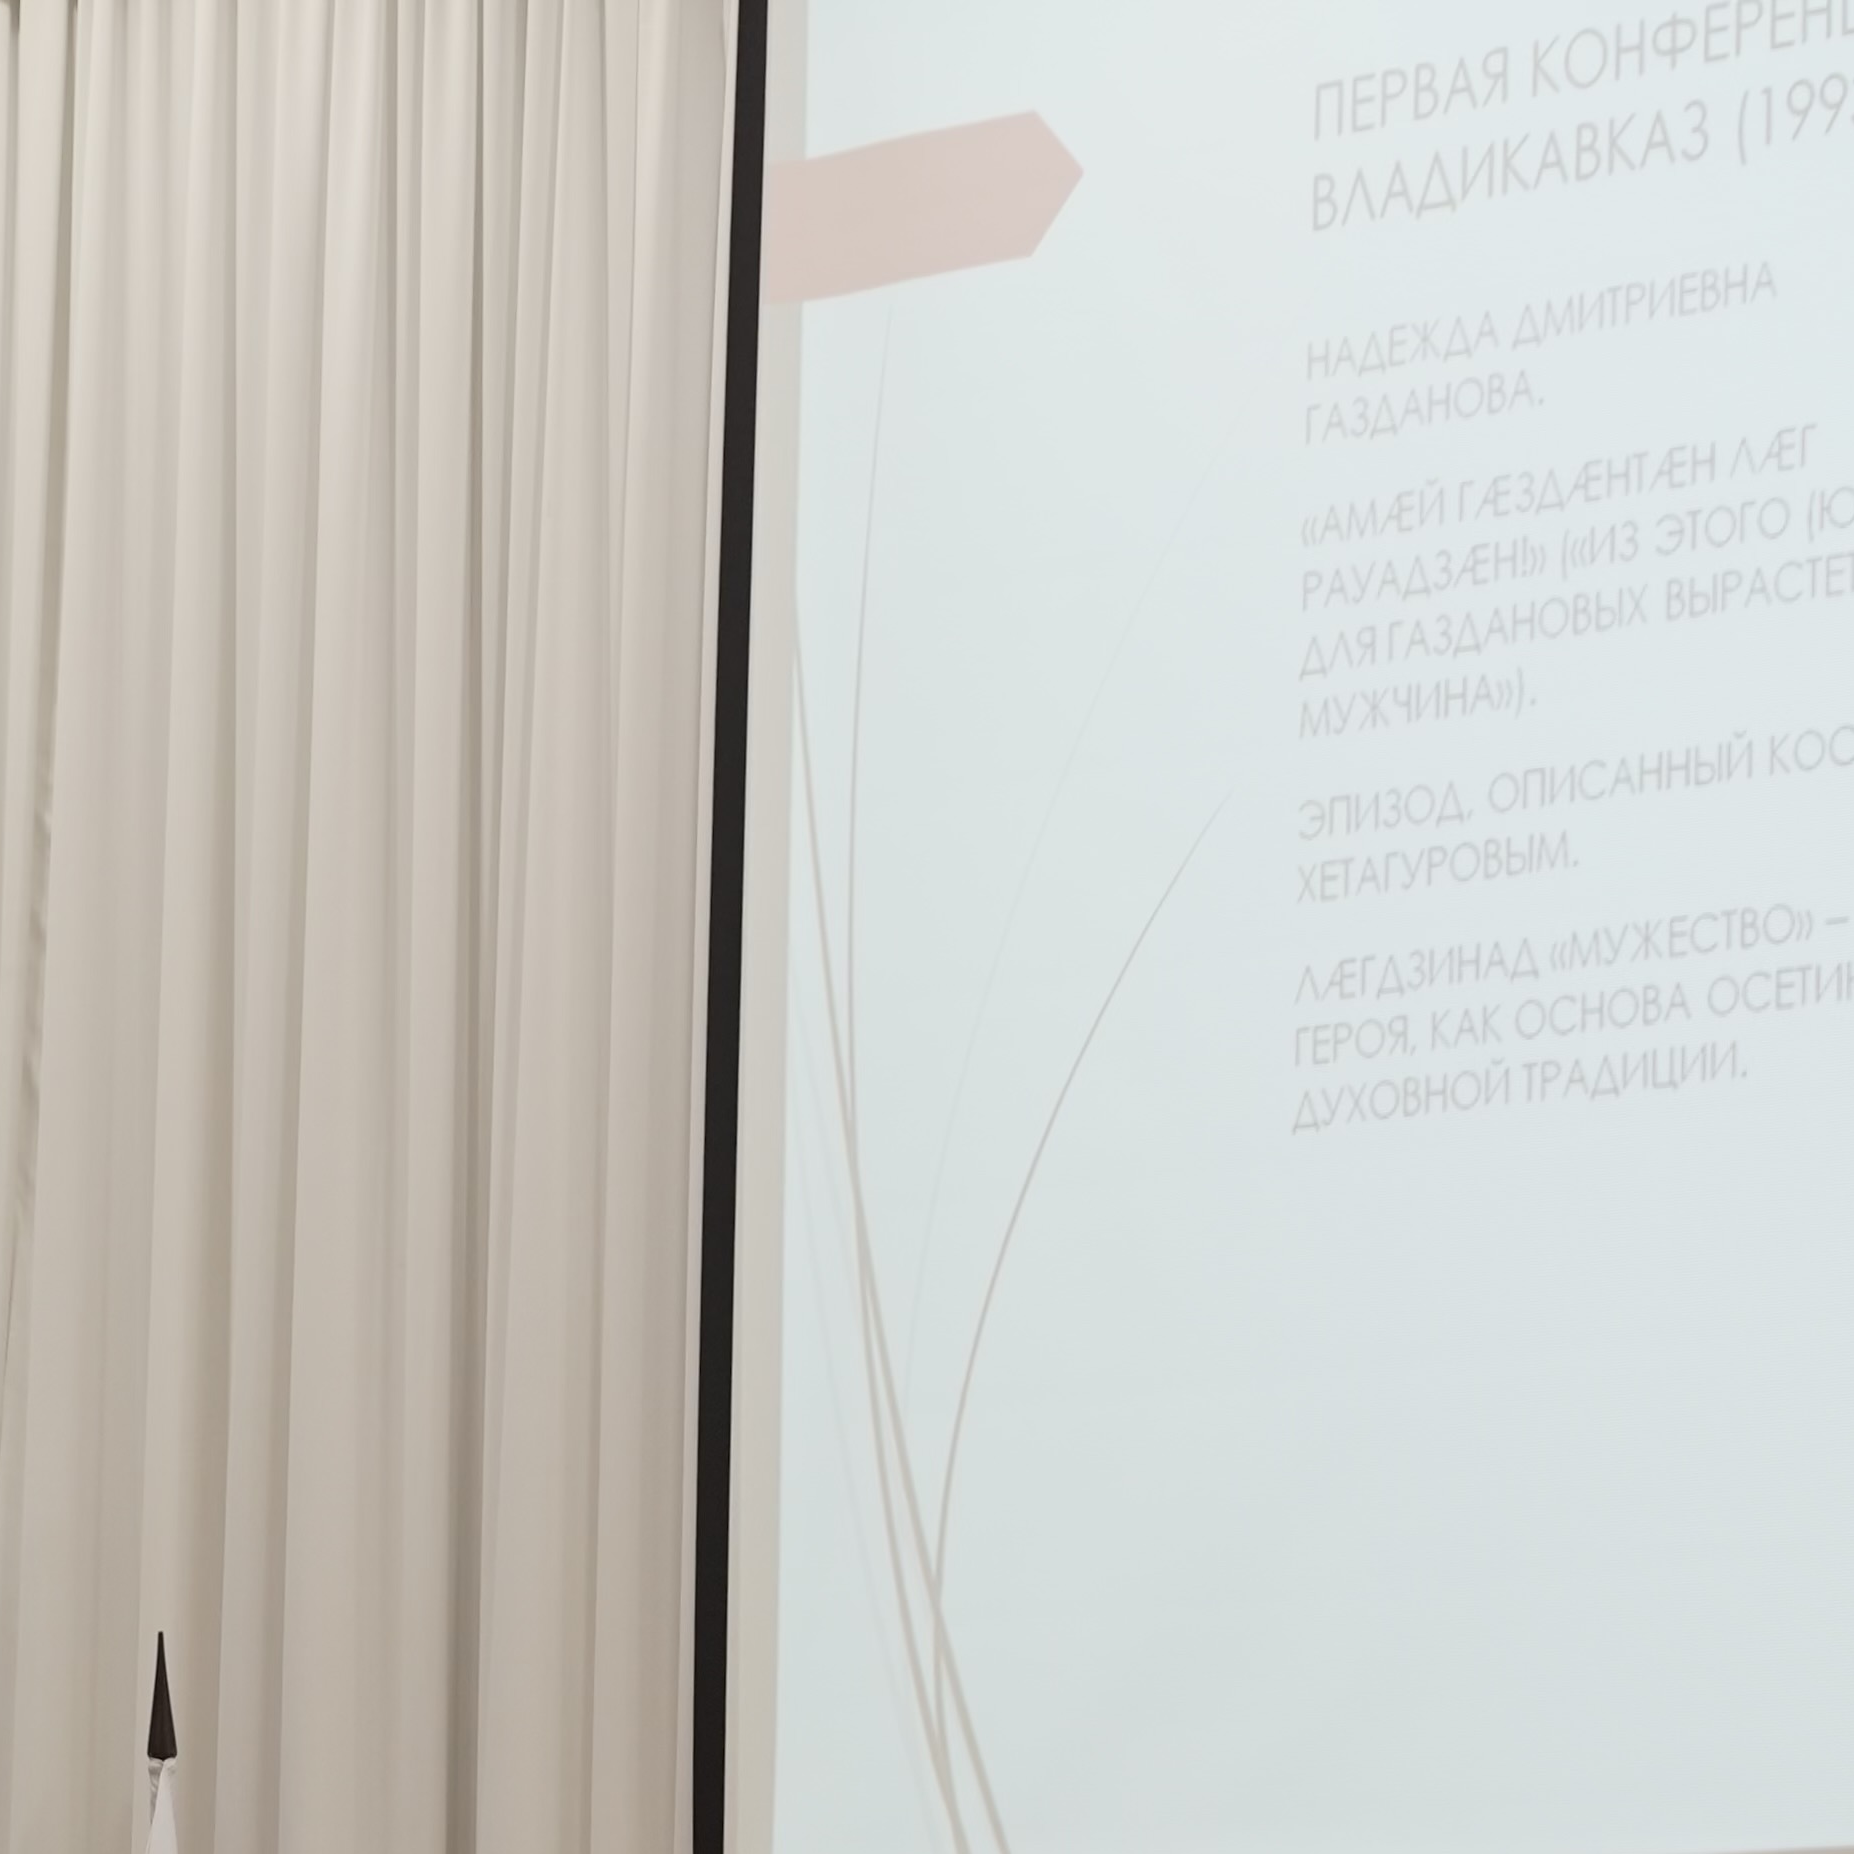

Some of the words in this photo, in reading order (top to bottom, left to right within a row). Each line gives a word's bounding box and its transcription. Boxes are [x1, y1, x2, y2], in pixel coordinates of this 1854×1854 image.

[1313, 45, 1509, 141] ПЕРВАЯ
[1311, 100, 1710, 232] ВЛАДИКАВКАЗ
[1306, 310, 1500, 382] НАДЕЖДА
[1512, 261, 1778, 352] ДМИТРИЕВНА
[1304, 370, 1544, 445] ГАЗДАНОВА.
[1561, 522, 1640, 584] («ИЗ
[1654, 495, 1791, 557] ЭТОГО
[1299, 625, 1377, 681] ДЛЯ
[1387, 583, 1648, 665] ГАЗДАНОВЫХ
[1299, 668, 1537, 739] МУЖЧИНА»).
[1298, 781, 1474, 841] ЭПИЗОД,
[1488, 732, 1754, 816] ОПИСАННЫЙ
[1297, 830, 1579, 905] ХЕТАГУРОВЫМ.
[1549, 902, 1814, 973] «МУЖЕСТВО»
[1293, 1014, 1416, 1067] ГЕРОЯ,
[1430, 1003, 1502, 1051] КАК
[1515, 981, 1692, 1042] ОСНОВА
[1292, 1057, 1510, 1134] ДУХОВНОЙ
[1522, 1041, 1748, 1103] ТРАДИЦИИ.
